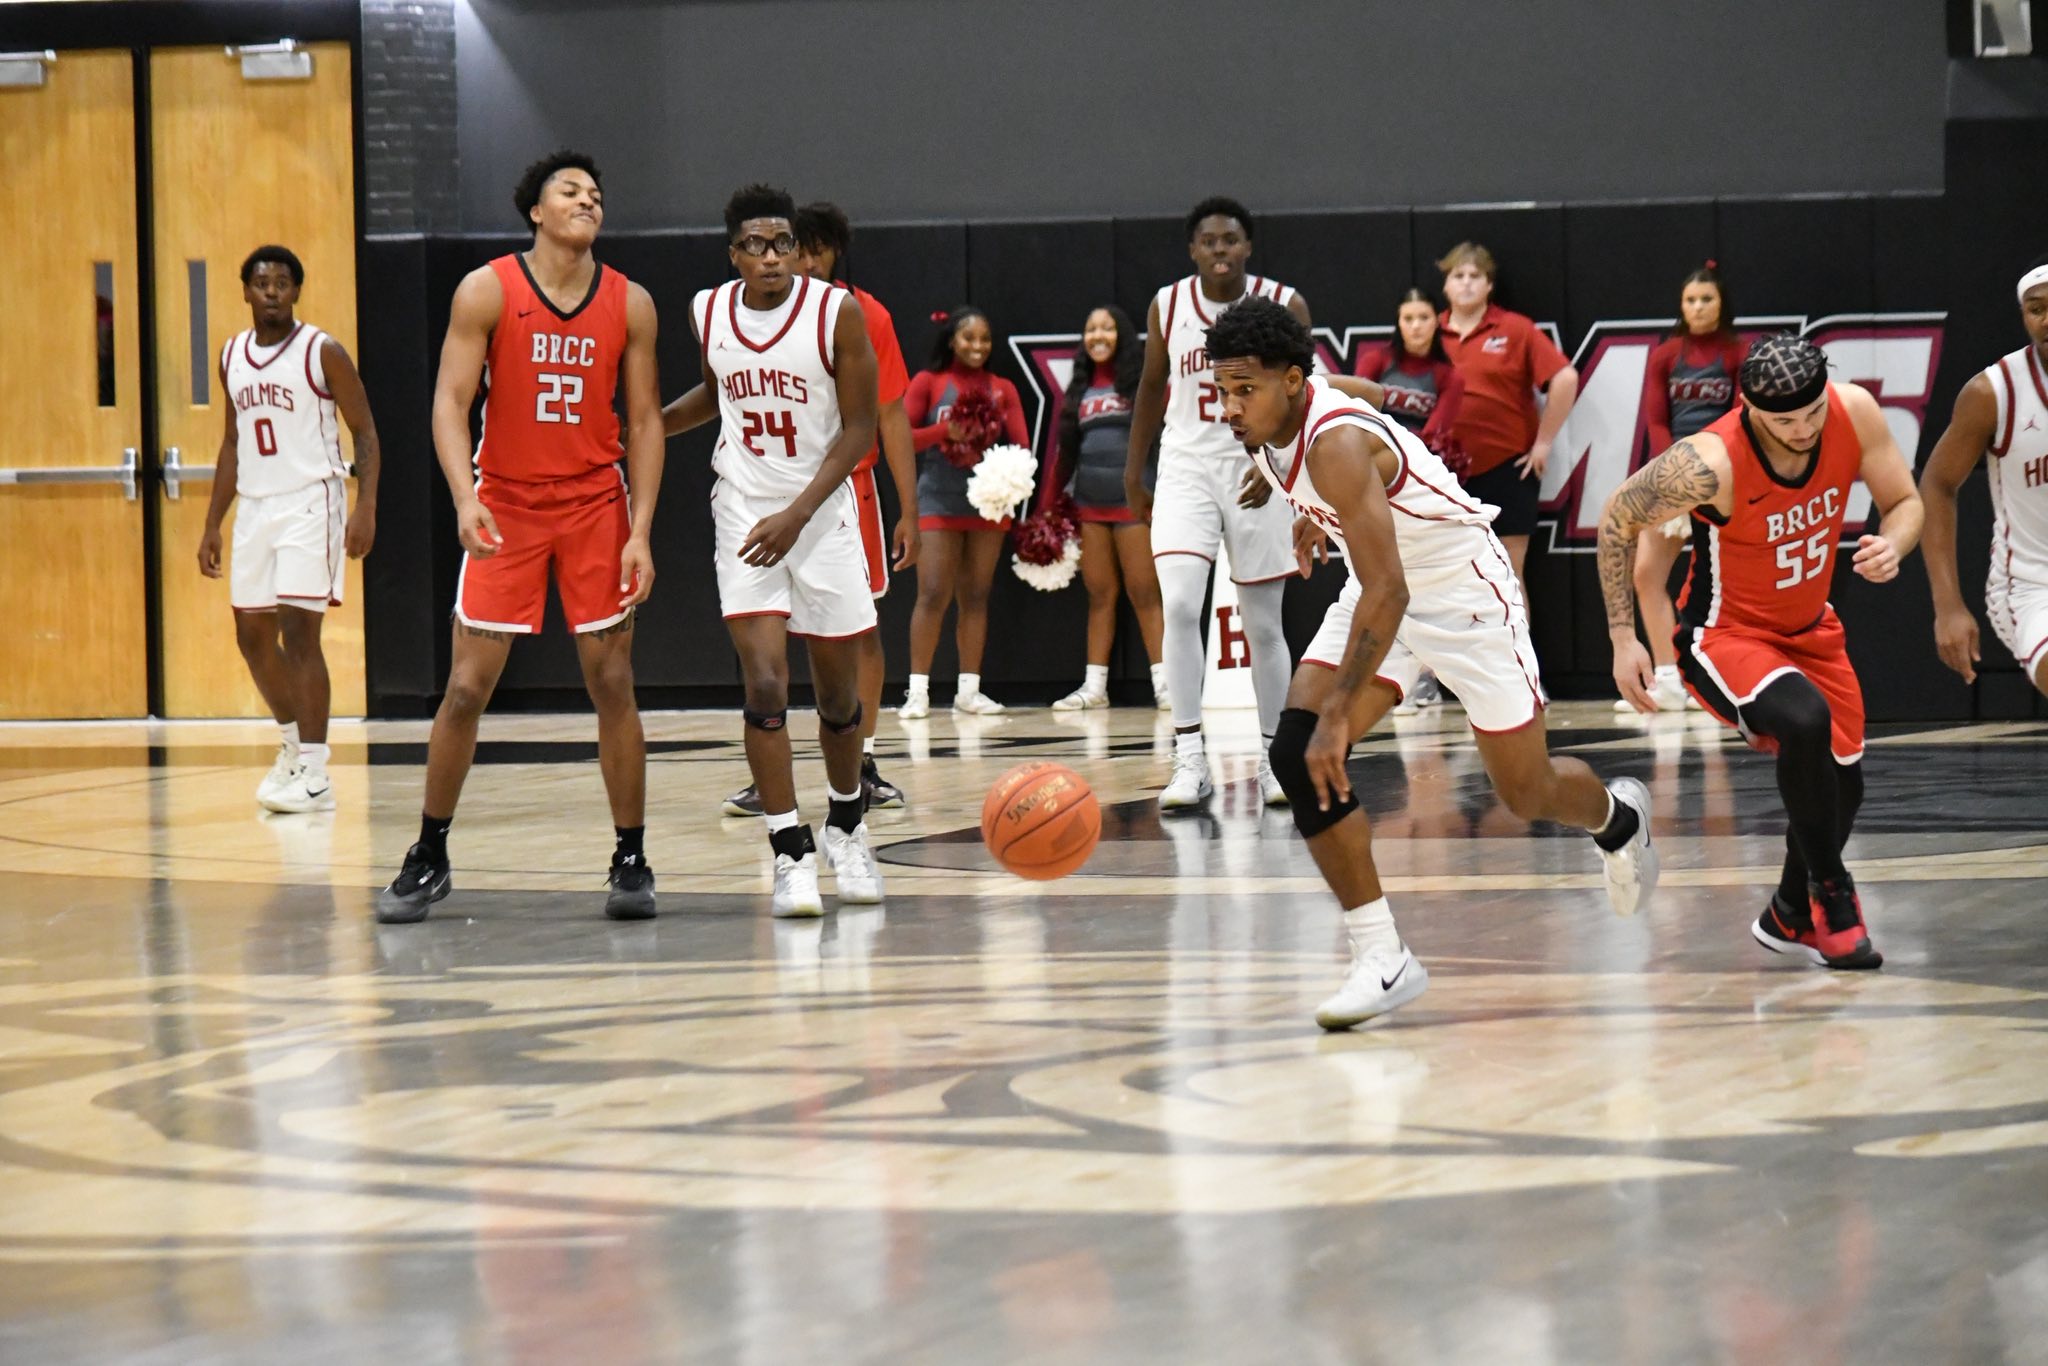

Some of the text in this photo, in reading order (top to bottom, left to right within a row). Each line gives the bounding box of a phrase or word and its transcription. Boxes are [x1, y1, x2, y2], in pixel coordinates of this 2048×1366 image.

[531, 332, 596, 367] BRCC
[235, 382, 294, 413] HOLMES
[536, 372, 584, 425] 22
[722, 367, 809, 404] HOLMES
[1198, 381, 1229, 424] 2
[254, 418, 278, 457] 0
[742, 410, 798, 458] 24
[1766, 487, 1840, 543] BRCC
[1775, 526, 1830, 590] 55
